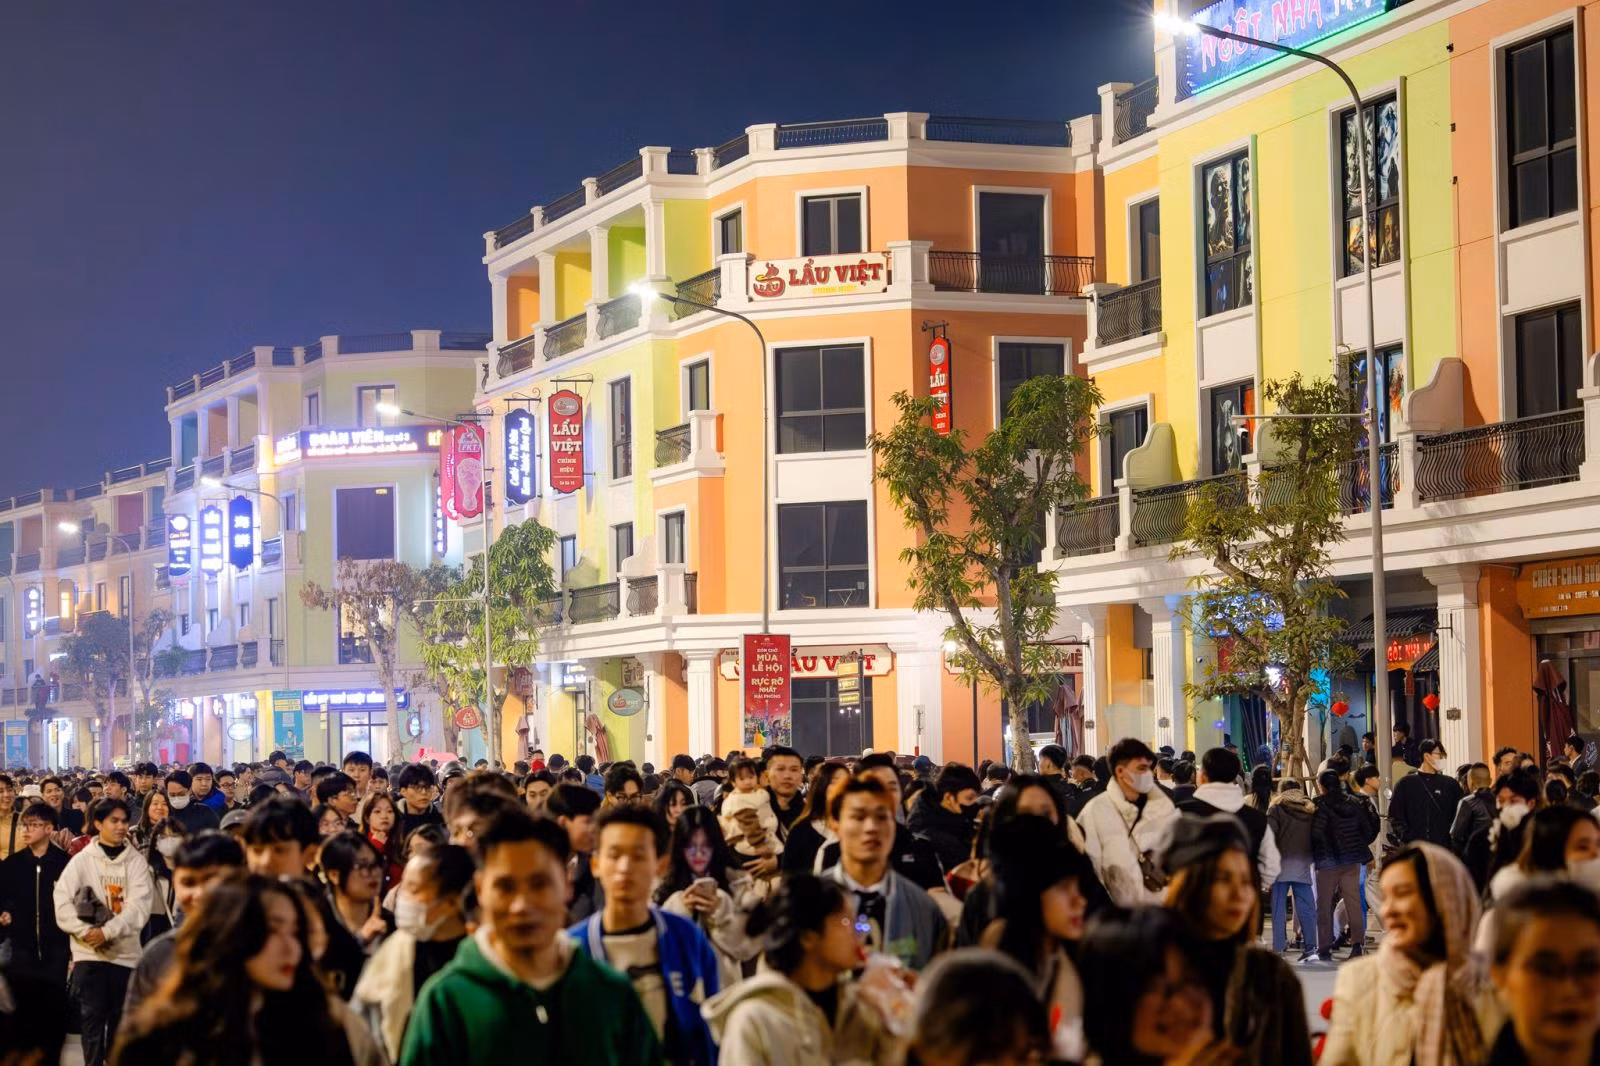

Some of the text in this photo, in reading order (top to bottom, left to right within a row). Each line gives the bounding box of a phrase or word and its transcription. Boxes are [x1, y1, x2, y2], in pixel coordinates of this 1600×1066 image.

[788, 258, 883, 286] LẨU VIỆT
[930, 367, 946, 388] LẨU
[553, 419, 580, 436] LẨU
[552, 438, 582, 454] VIỆT
[757, 653, 778, 662] MÙA
[1387, 641, 1402, 661] GÔI
[752, 662, 783, 673] LỄ HỘI
[791, 648, 817, 671] ẨU
[751, 676, 784, 688] RỰC RỠ
[759, 685, 777, 693] NHẤT
